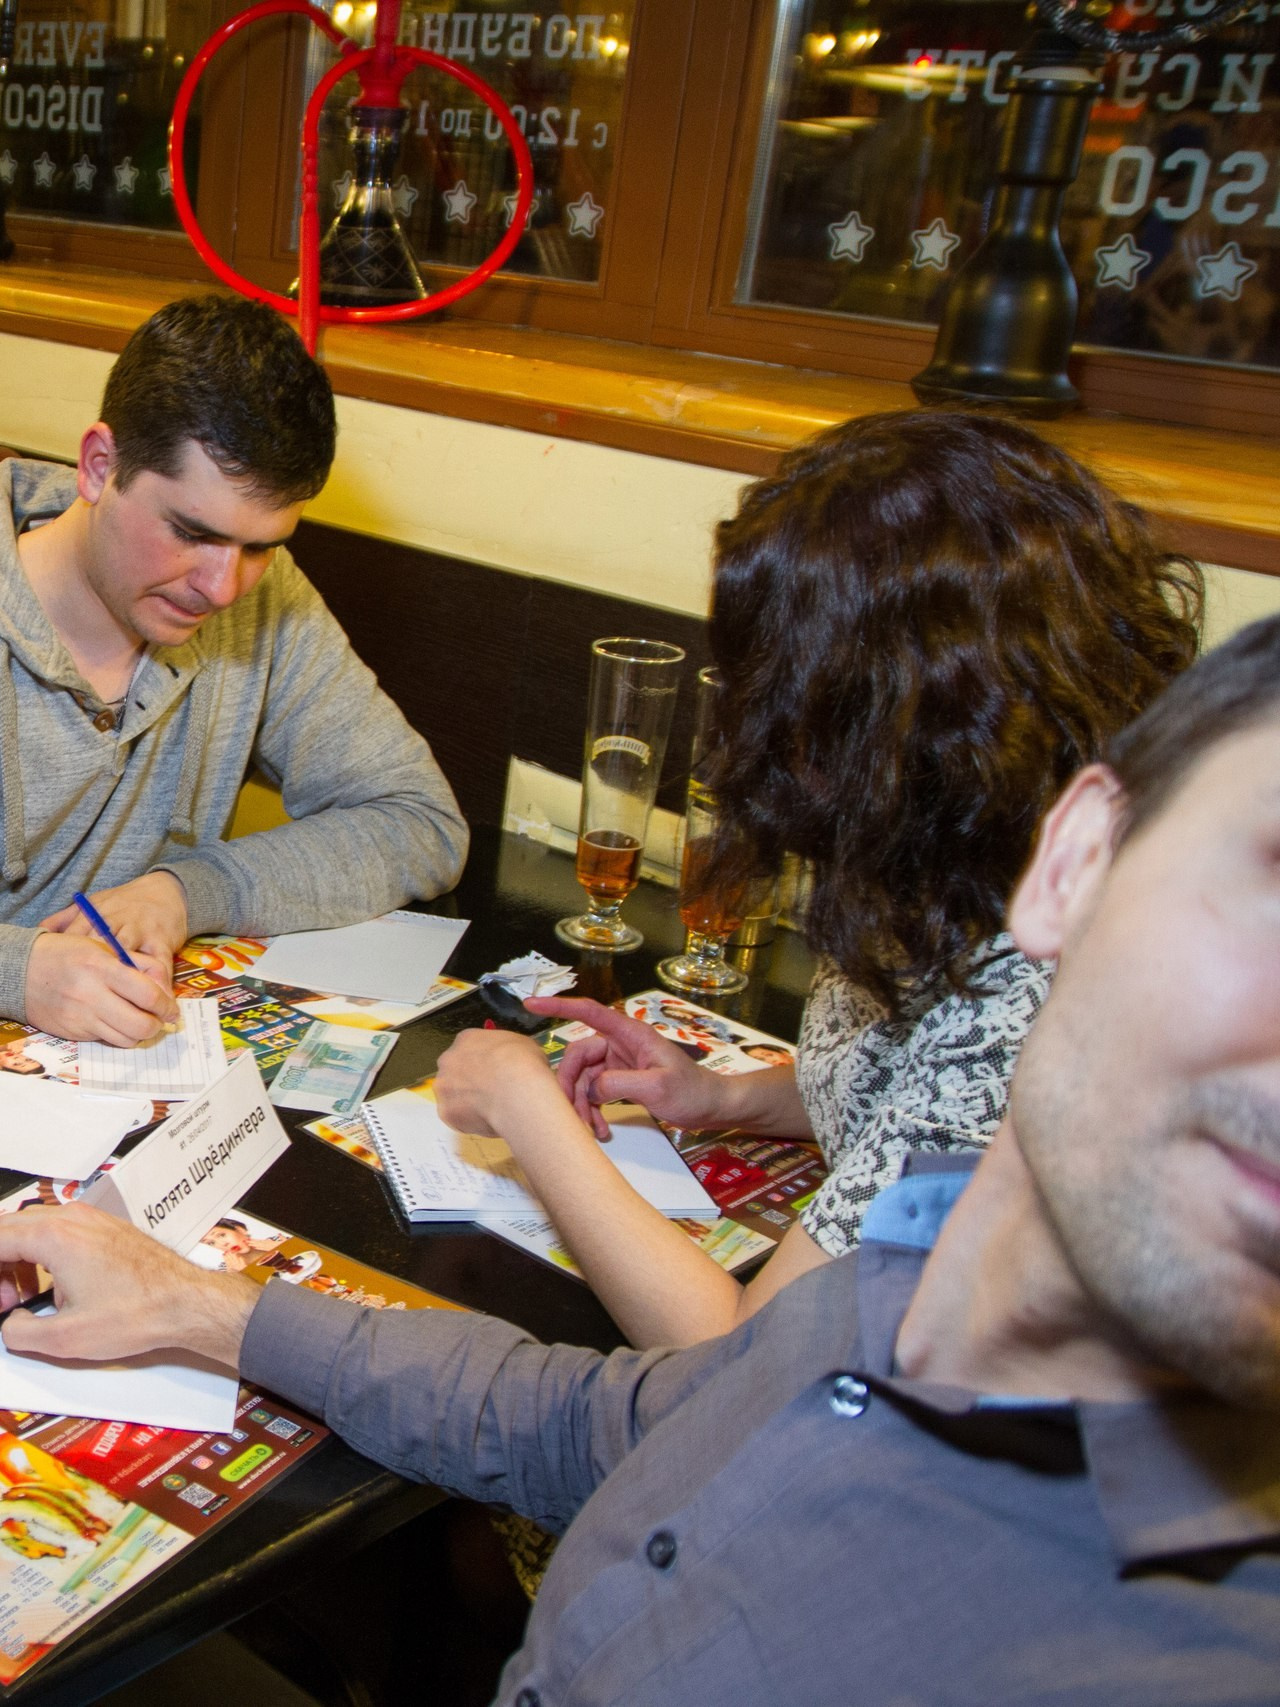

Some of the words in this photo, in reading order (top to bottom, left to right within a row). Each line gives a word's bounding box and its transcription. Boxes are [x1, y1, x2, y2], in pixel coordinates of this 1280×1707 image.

[142, 1180, 193, 1230] Котята
[190, 1103, 268, 1188] Шрёдингера
[92, 1418, 126, 1458] ПОДАРО
[132, 1429, 152, 1446] НА
[228, 1452, 260, 1477] СКАЧАТЬ
